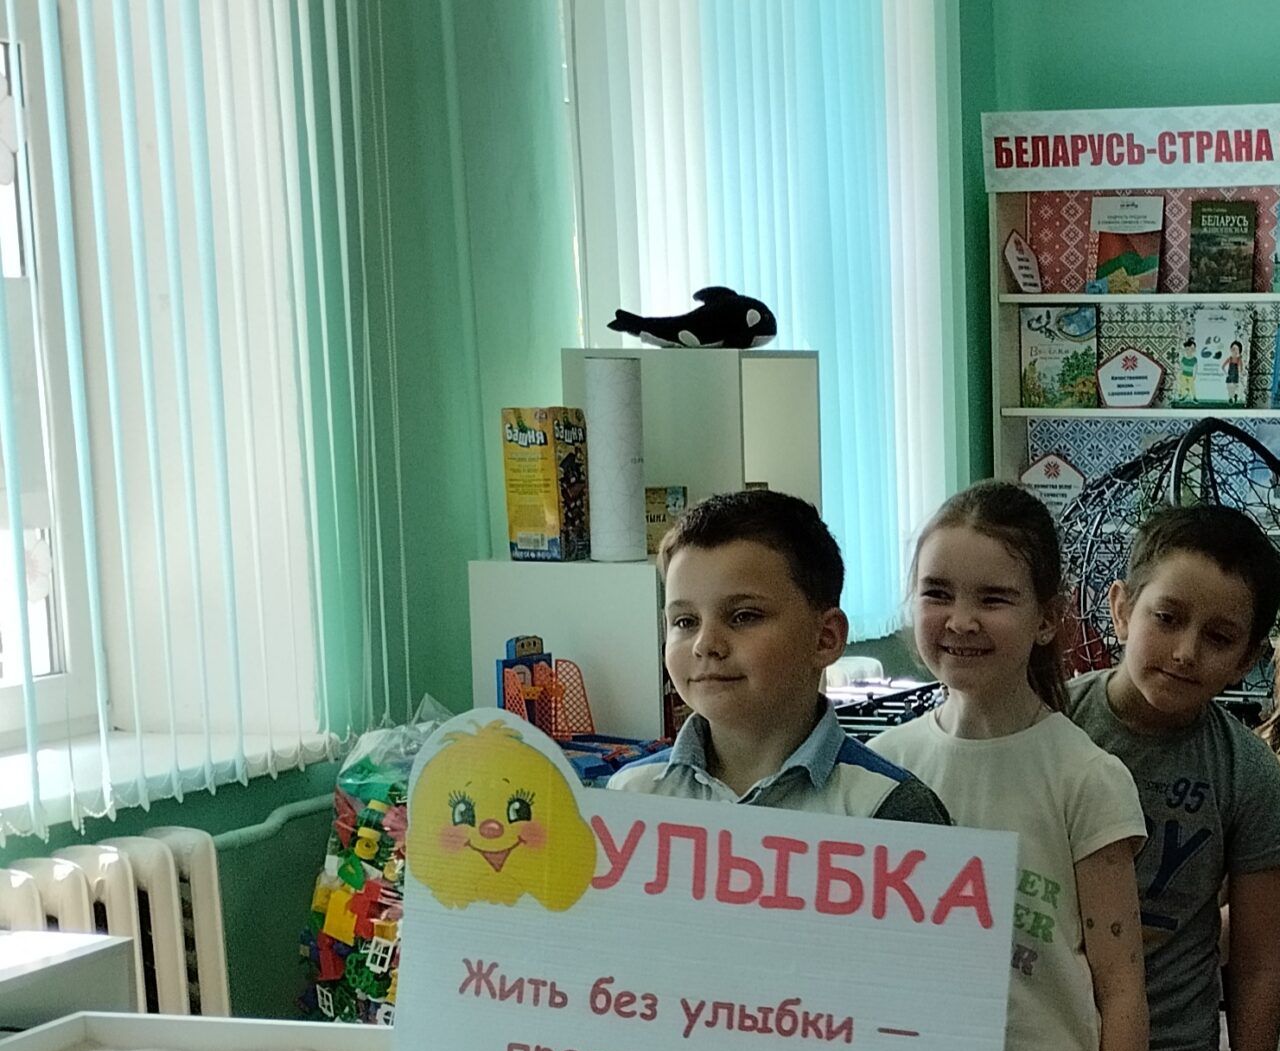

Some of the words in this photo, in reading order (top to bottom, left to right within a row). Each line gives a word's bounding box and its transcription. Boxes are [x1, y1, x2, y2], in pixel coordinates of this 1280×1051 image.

[994, 128, 1275, 169] БЕЛАРУСЬ-СТРАНА
[1201, 214, 1249, 227] БЕЛАРУСЬ
[1166, 777, 1211, 814] 95
[591, 814, 995, 930] УЛЫБКА
[458, 957, 568, 1010] Жить
[589, 975, 659, 1023] без
[681, 997, 854, 1044] улыбки
